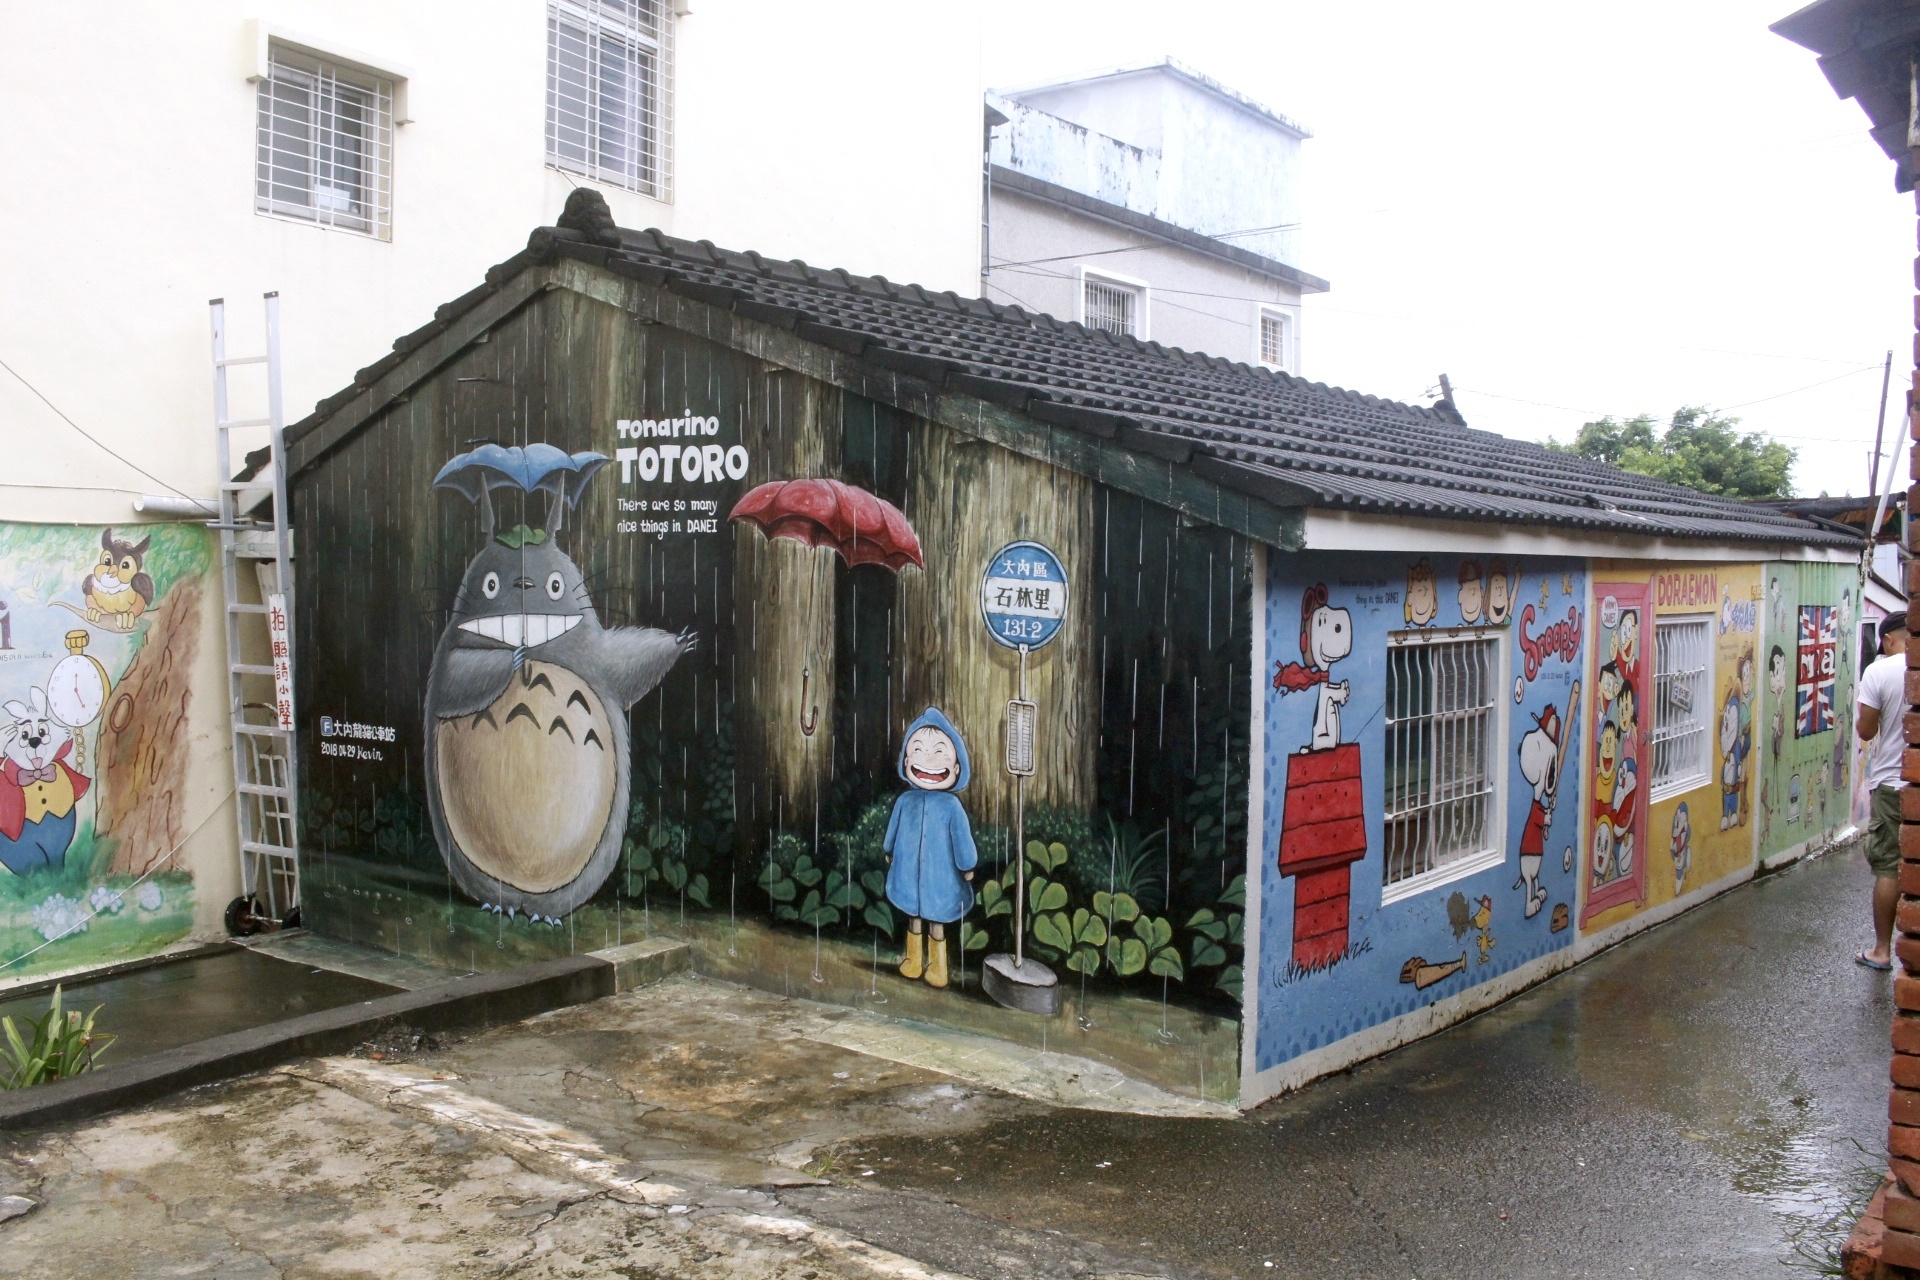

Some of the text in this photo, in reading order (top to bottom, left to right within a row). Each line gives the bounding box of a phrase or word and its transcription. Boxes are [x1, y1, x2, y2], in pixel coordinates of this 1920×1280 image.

[617, 408, 719, 439] Tonarino
[616, 444, 749, 484] TOTORO
[617, 498, 718, 516] There are so many
[617, 519, 718, 540] nice things in DANEI
[994, 586, 1050, 611] 石林里
[1658, 573, 1717, 606] DORAEMON
[1003, 619, 1042, 638] 131-2
[1519, 604, 1582, 682] Snoopy
[357, 745, 383, 761] Kevin
